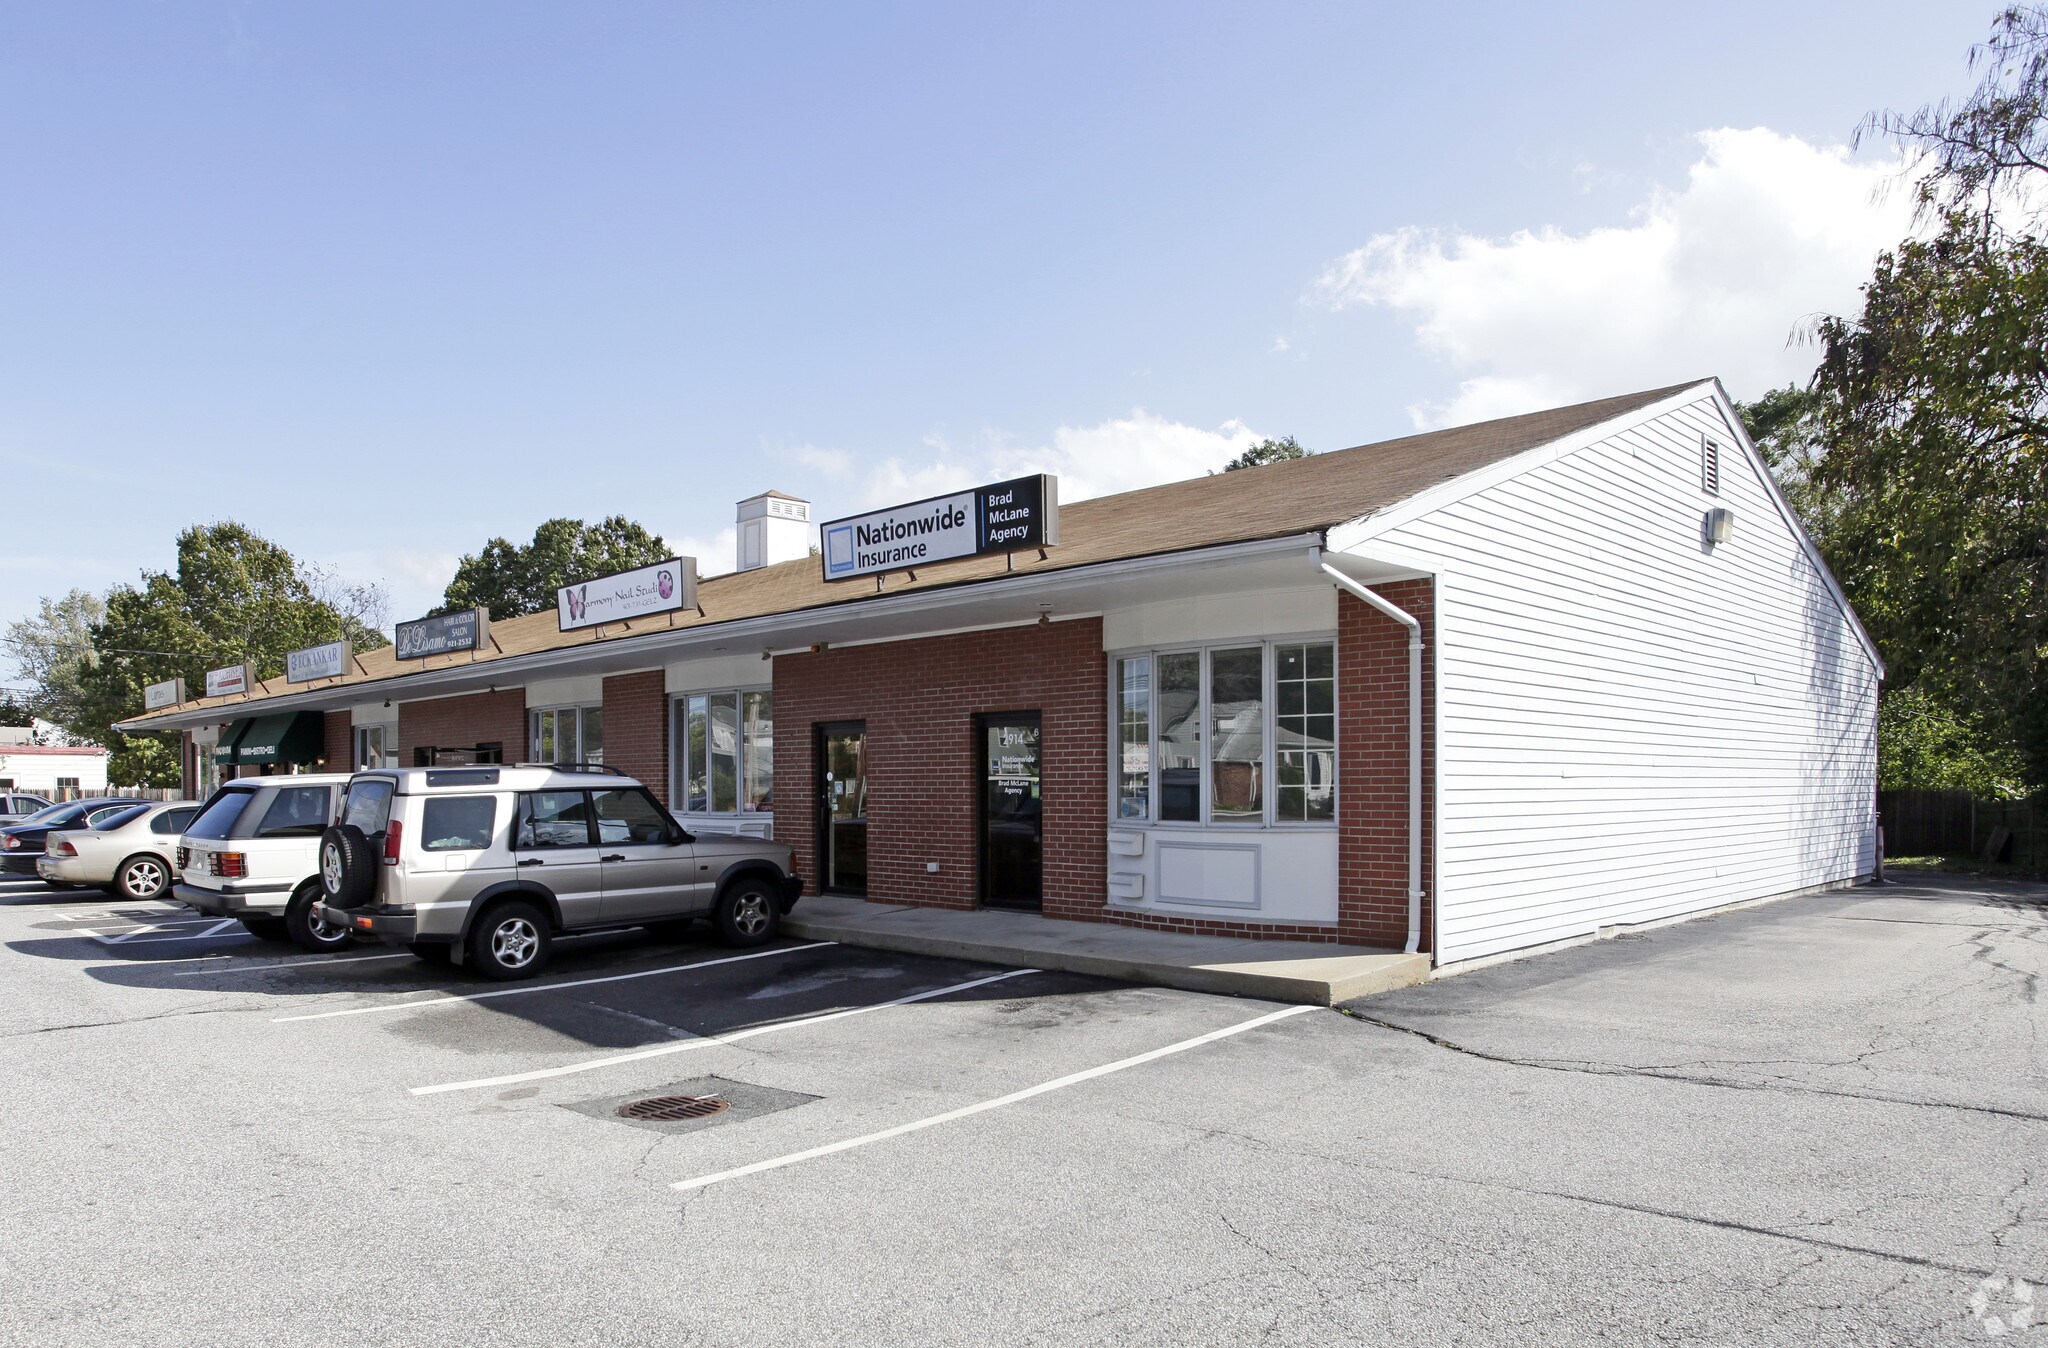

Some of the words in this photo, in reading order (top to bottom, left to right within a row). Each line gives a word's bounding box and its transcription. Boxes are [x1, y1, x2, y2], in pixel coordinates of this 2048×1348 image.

[989, 490, 1013, 507] Brad
[989, 506, 1029, 524] McLane
[856, 504, 966, 547] Nationwide
[989, 524, 1029, 542] Agency
[857, 541, 927, 569] Insurance
[615, 587, 634, 602] Nail
[459, 613, 475, 625] COLOR
[451, 626, 468, 638] SALON
[298, 647, 338, 668] ECKANKAR
[1002, 733, 1024, 745] 2914
[1033, 728, 1040, 737] 6
[1001, 755, 1035, 763] Nationwide
[1004, 787, 1023, 795] Agency
